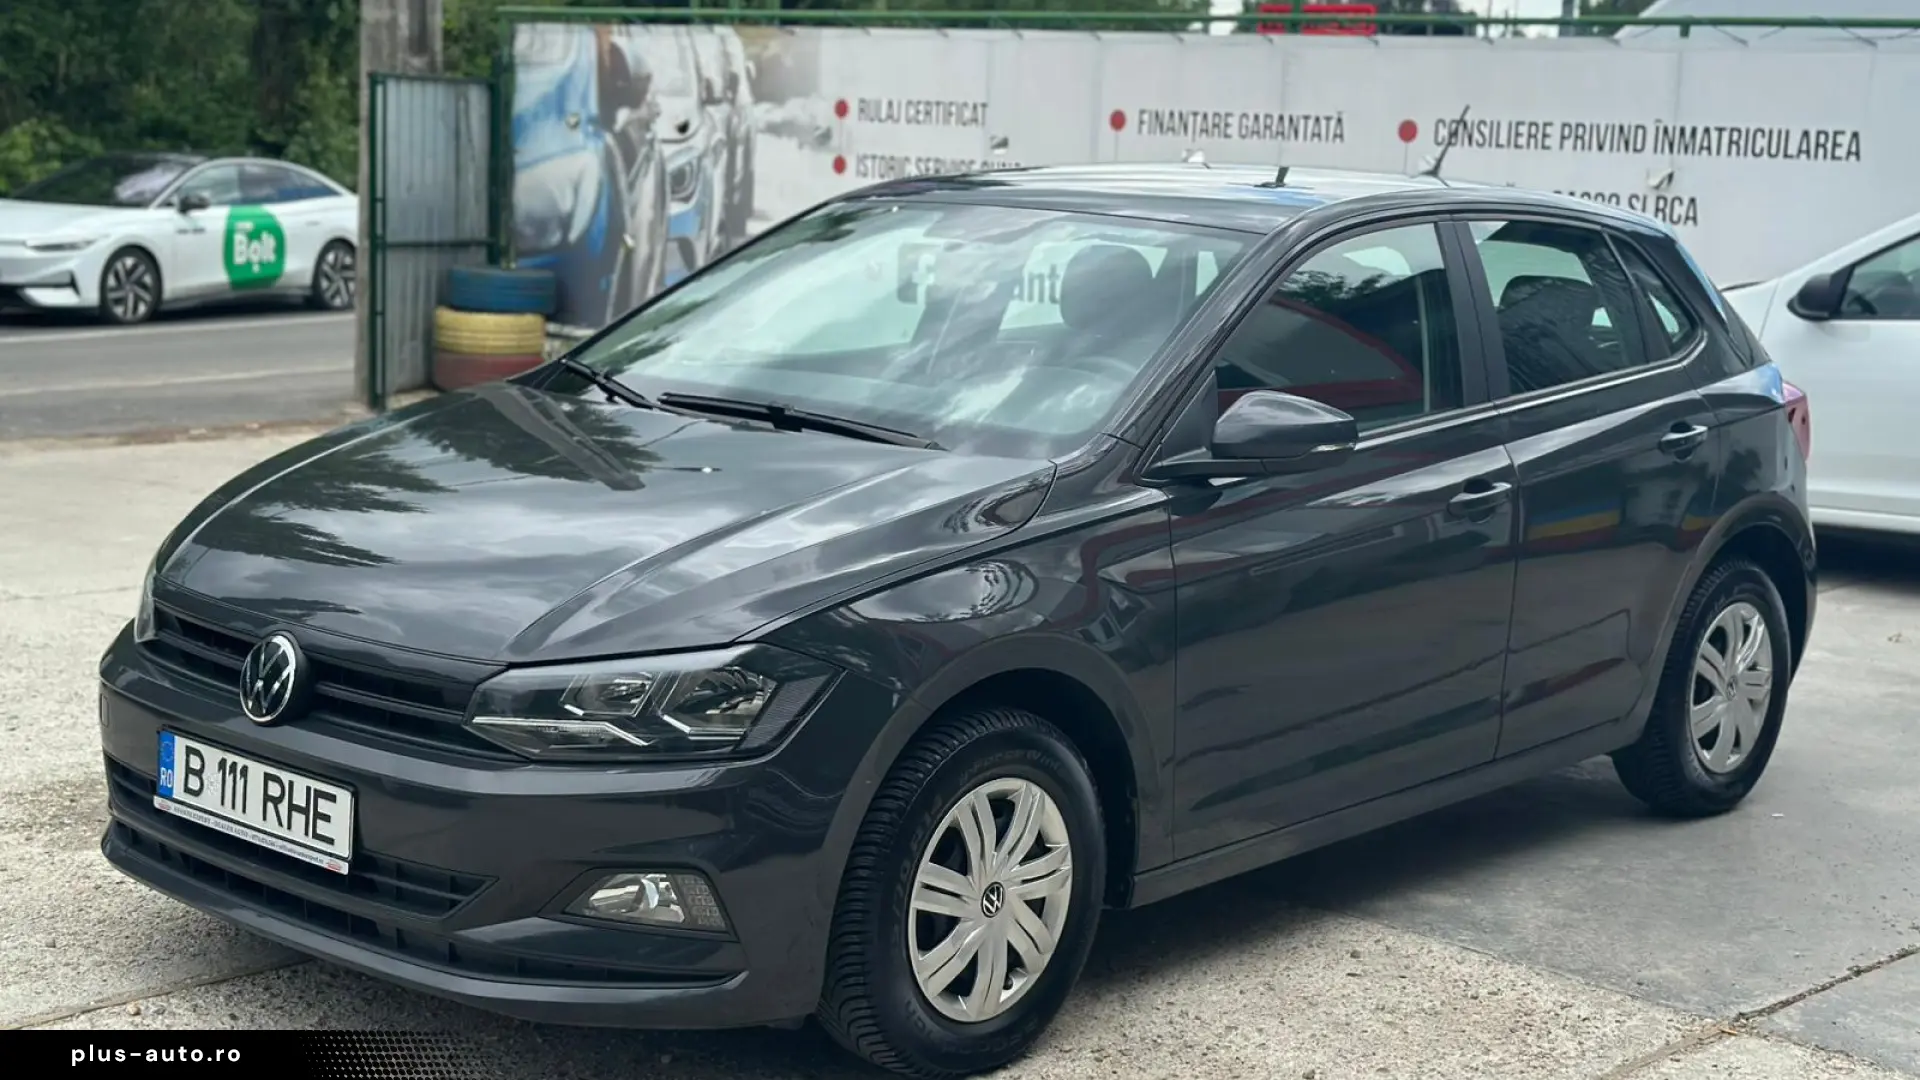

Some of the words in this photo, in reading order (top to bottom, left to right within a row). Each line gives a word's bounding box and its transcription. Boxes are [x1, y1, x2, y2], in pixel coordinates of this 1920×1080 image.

[857, 99, 901, 124] RULAJ
[905, 101, 988, 128] CERTIFICAT
[1238, 110, 1346, 144] GARANTATĂ
[1433, 118, 1553, 152] CONSILIERE
[1559, 121, 1646, 154] PRIVIND
[1652, 117, 1862, 162] ÎNMATRICULAREA
[855, 153, 910, 179] ISTORIC
[1654, 195, 1698, 226] RCA
[233, 231, 276, 266] Bolt
[160, 767, 173, 788] RO
[183, 744, 205, 797] B
[218, 757, 249, 815] 111
[263, 771, 337, 846] RHE
